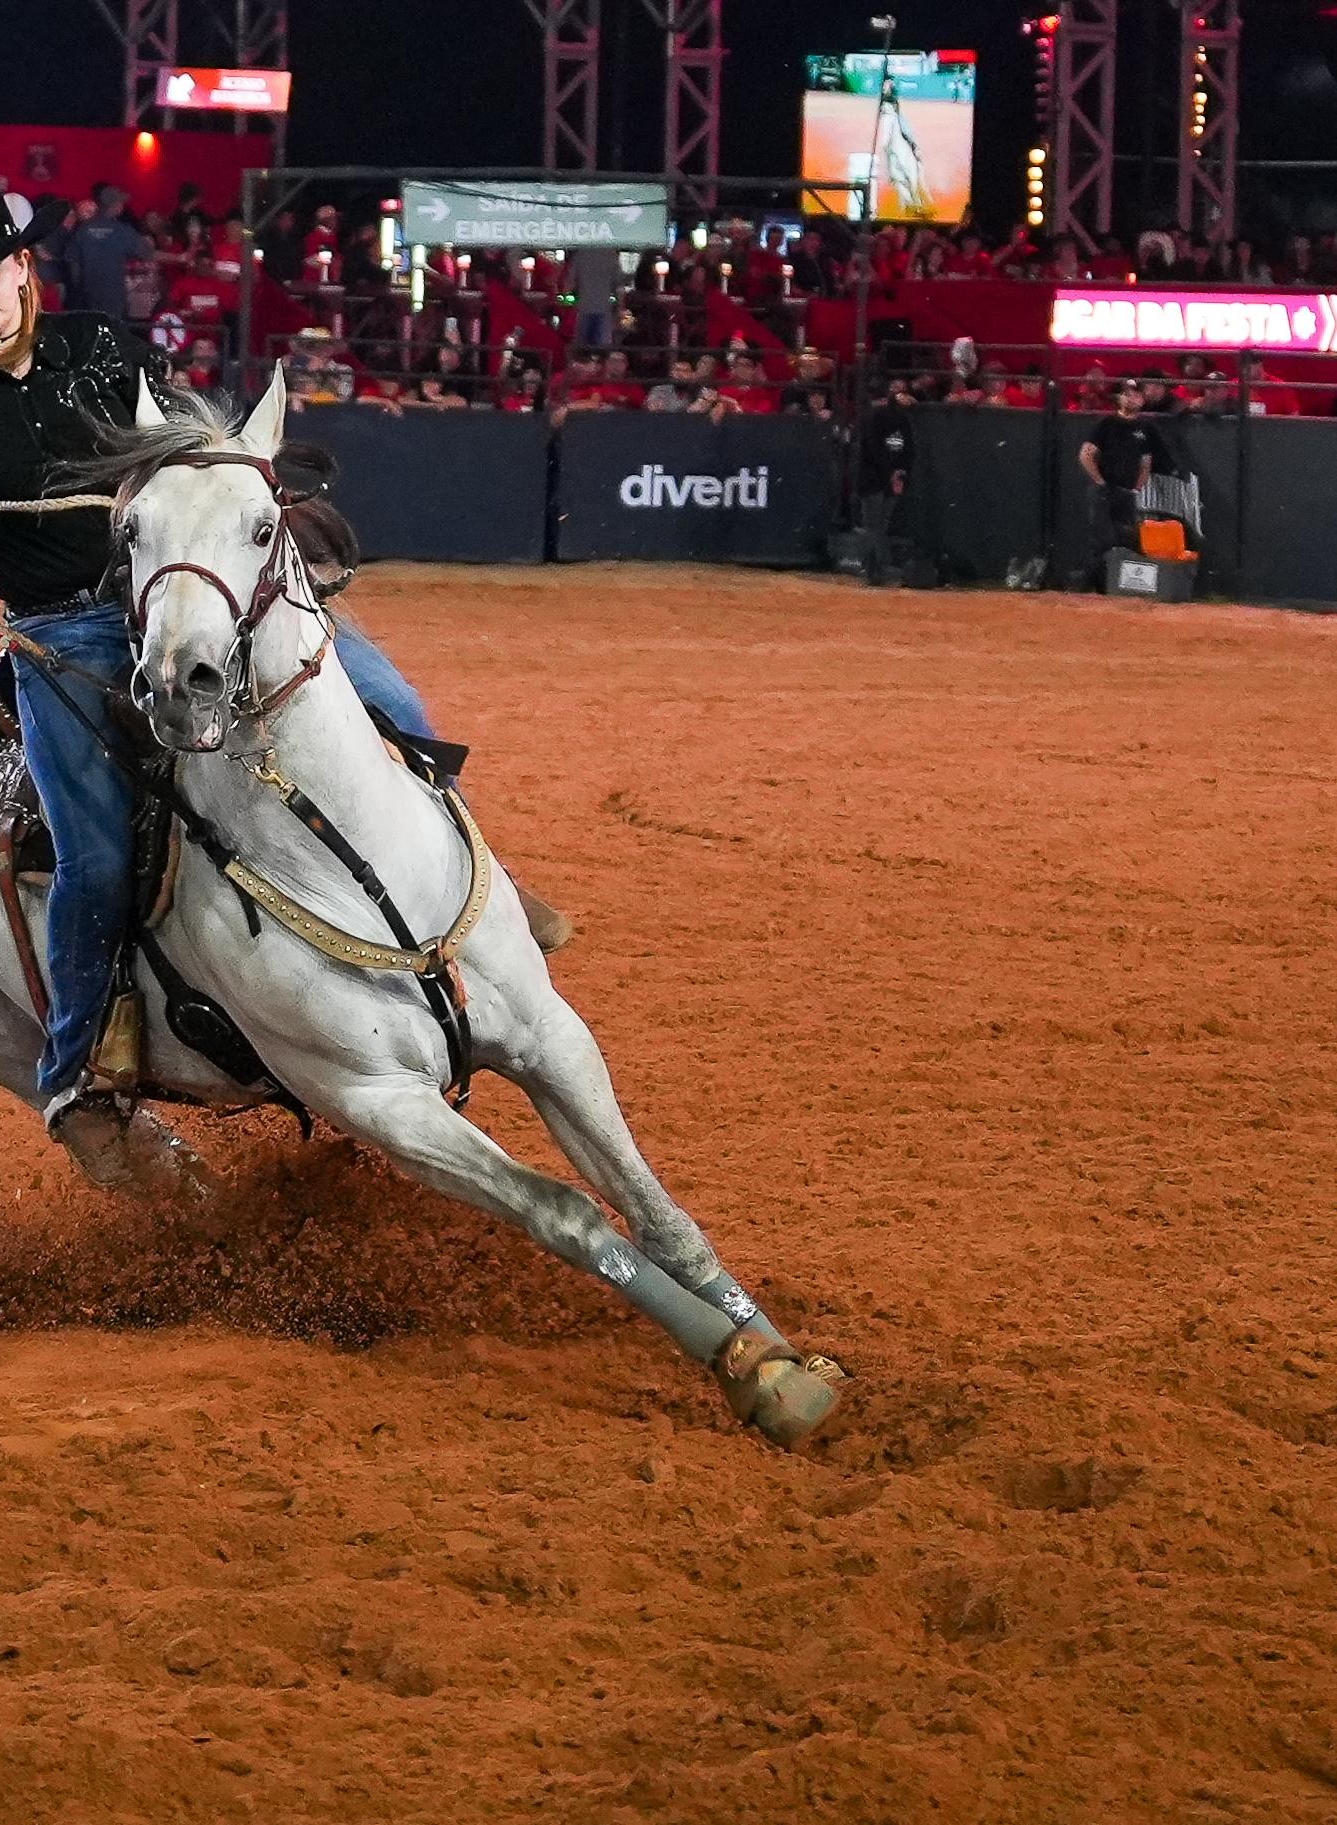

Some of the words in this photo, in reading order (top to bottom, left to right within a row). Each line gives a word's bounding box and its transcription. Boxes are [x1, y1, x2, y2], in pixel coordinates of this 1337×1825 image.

[558, 193, 590, 212] DE
[456, 217, 613, 240] EMERGÊNCIA
[1137, 301, 1186, 341] DA
[1186, 302, 1292, 342] FESTA
[620, 464, 768, 507] diverti
